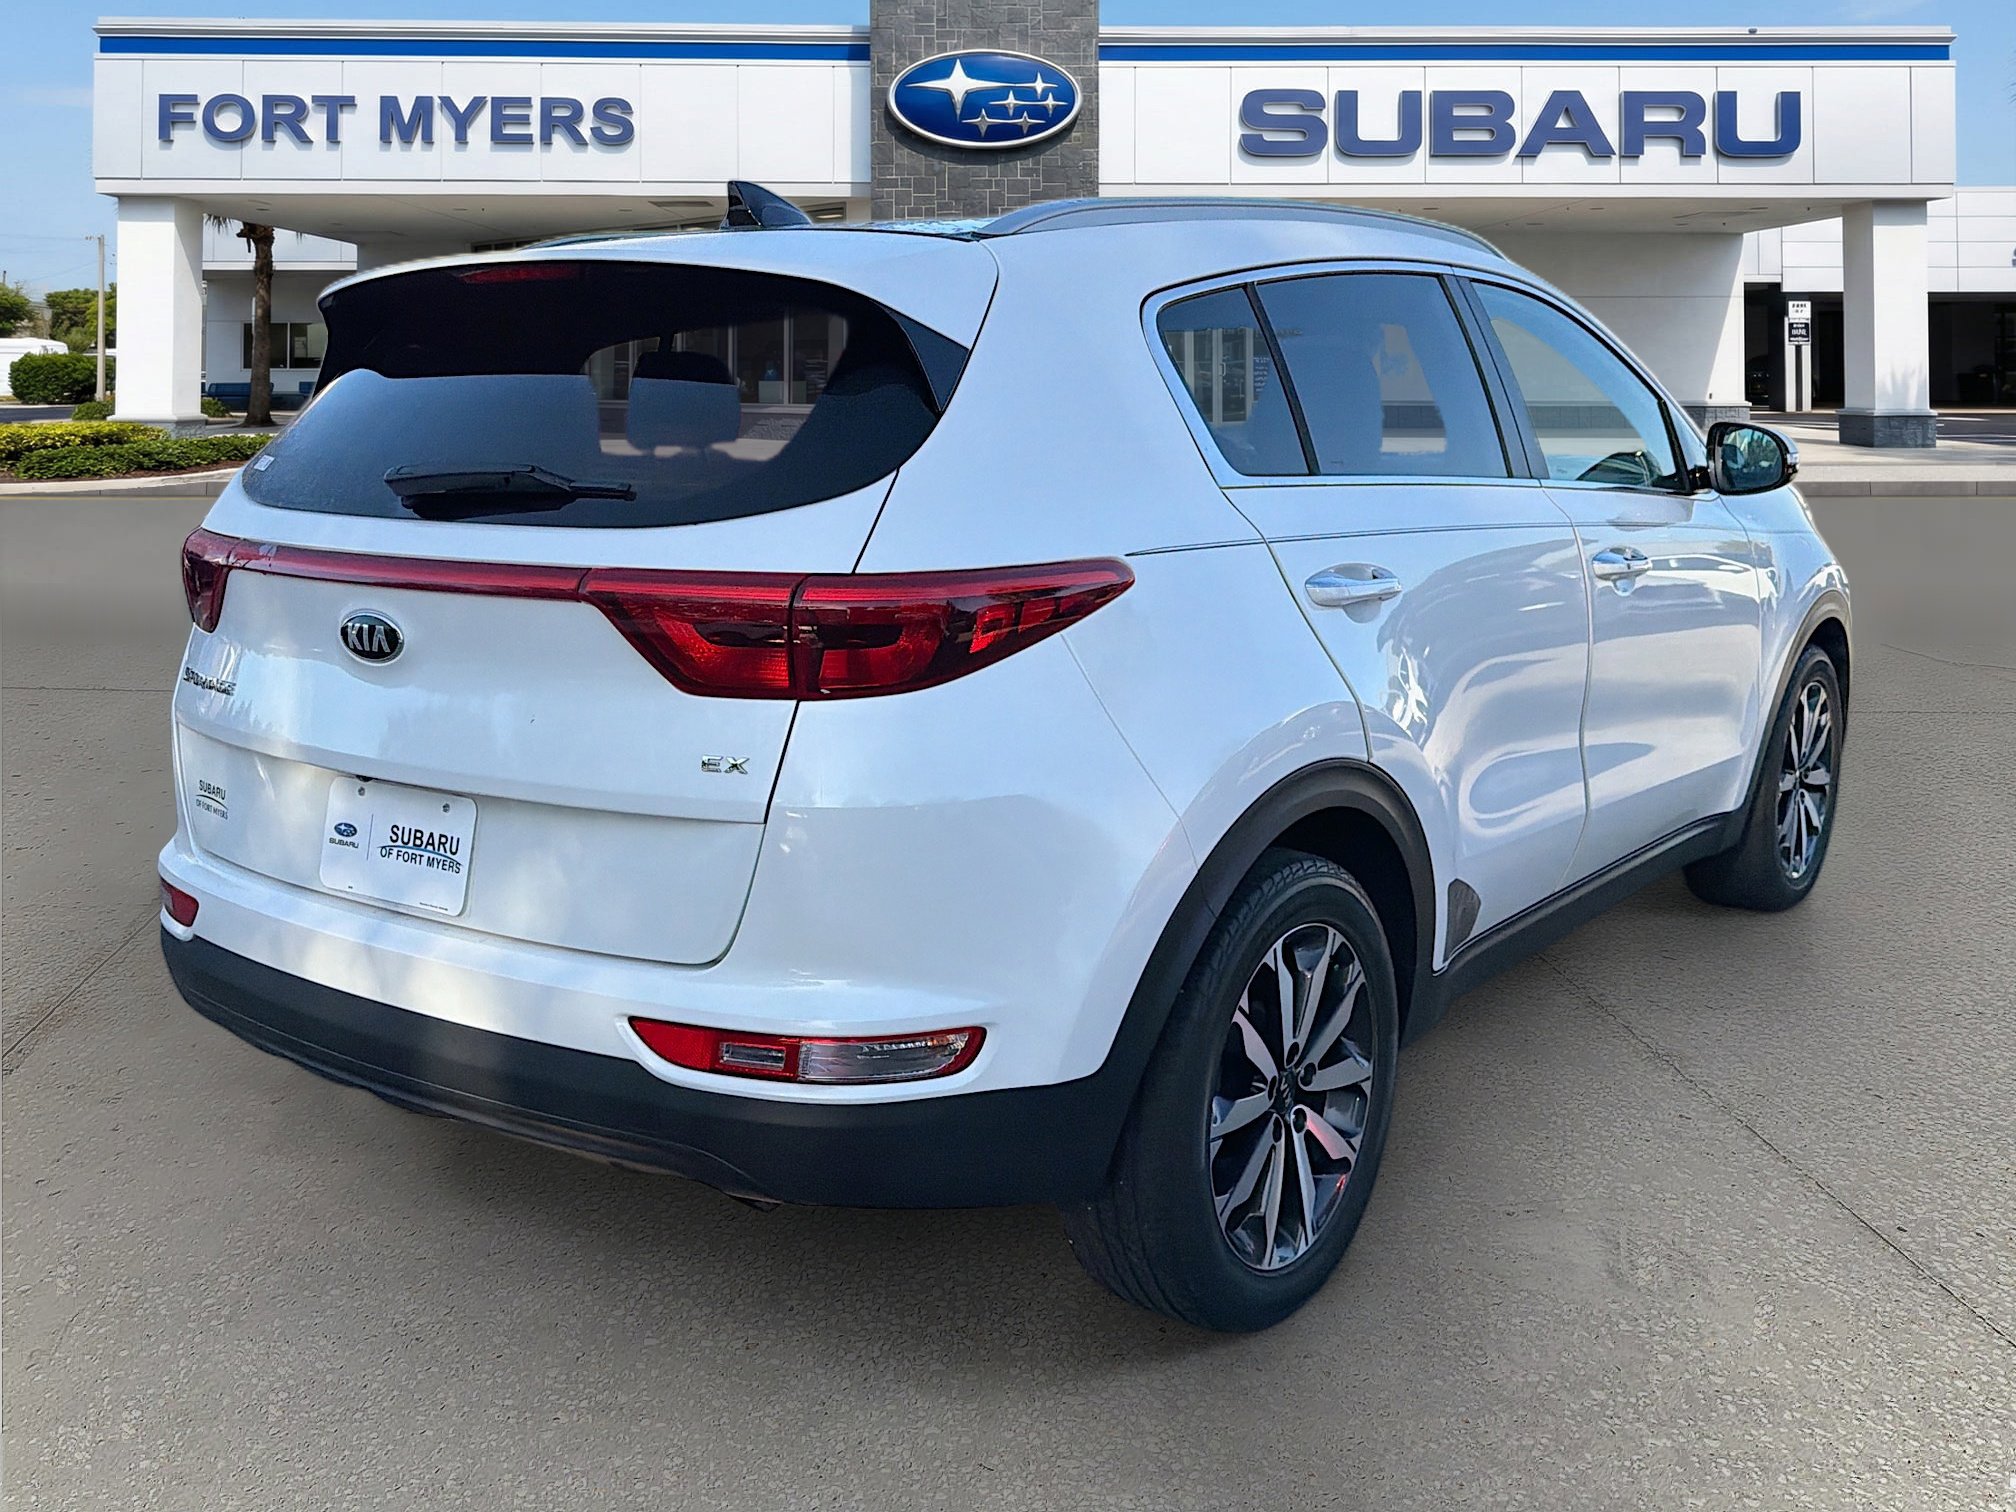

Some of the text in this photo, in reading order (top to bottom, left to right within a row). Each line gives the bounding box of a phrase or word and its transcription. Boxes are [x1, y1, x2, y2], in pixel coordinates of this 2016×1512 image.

[158, 93, 635, 146] FORT MYERS
[1239, 88, 1802, 158] SUBARU
[347, 622, 391, 653] KIA
[701, 755, 750, 775] EX
[198, 779, 226, 801] SUBARU
[328, 837, 359, 849] SUBARU
[389, 824, 460, 856] SUBARU
[380, 846, 461, 874] OF FORT MYERS
